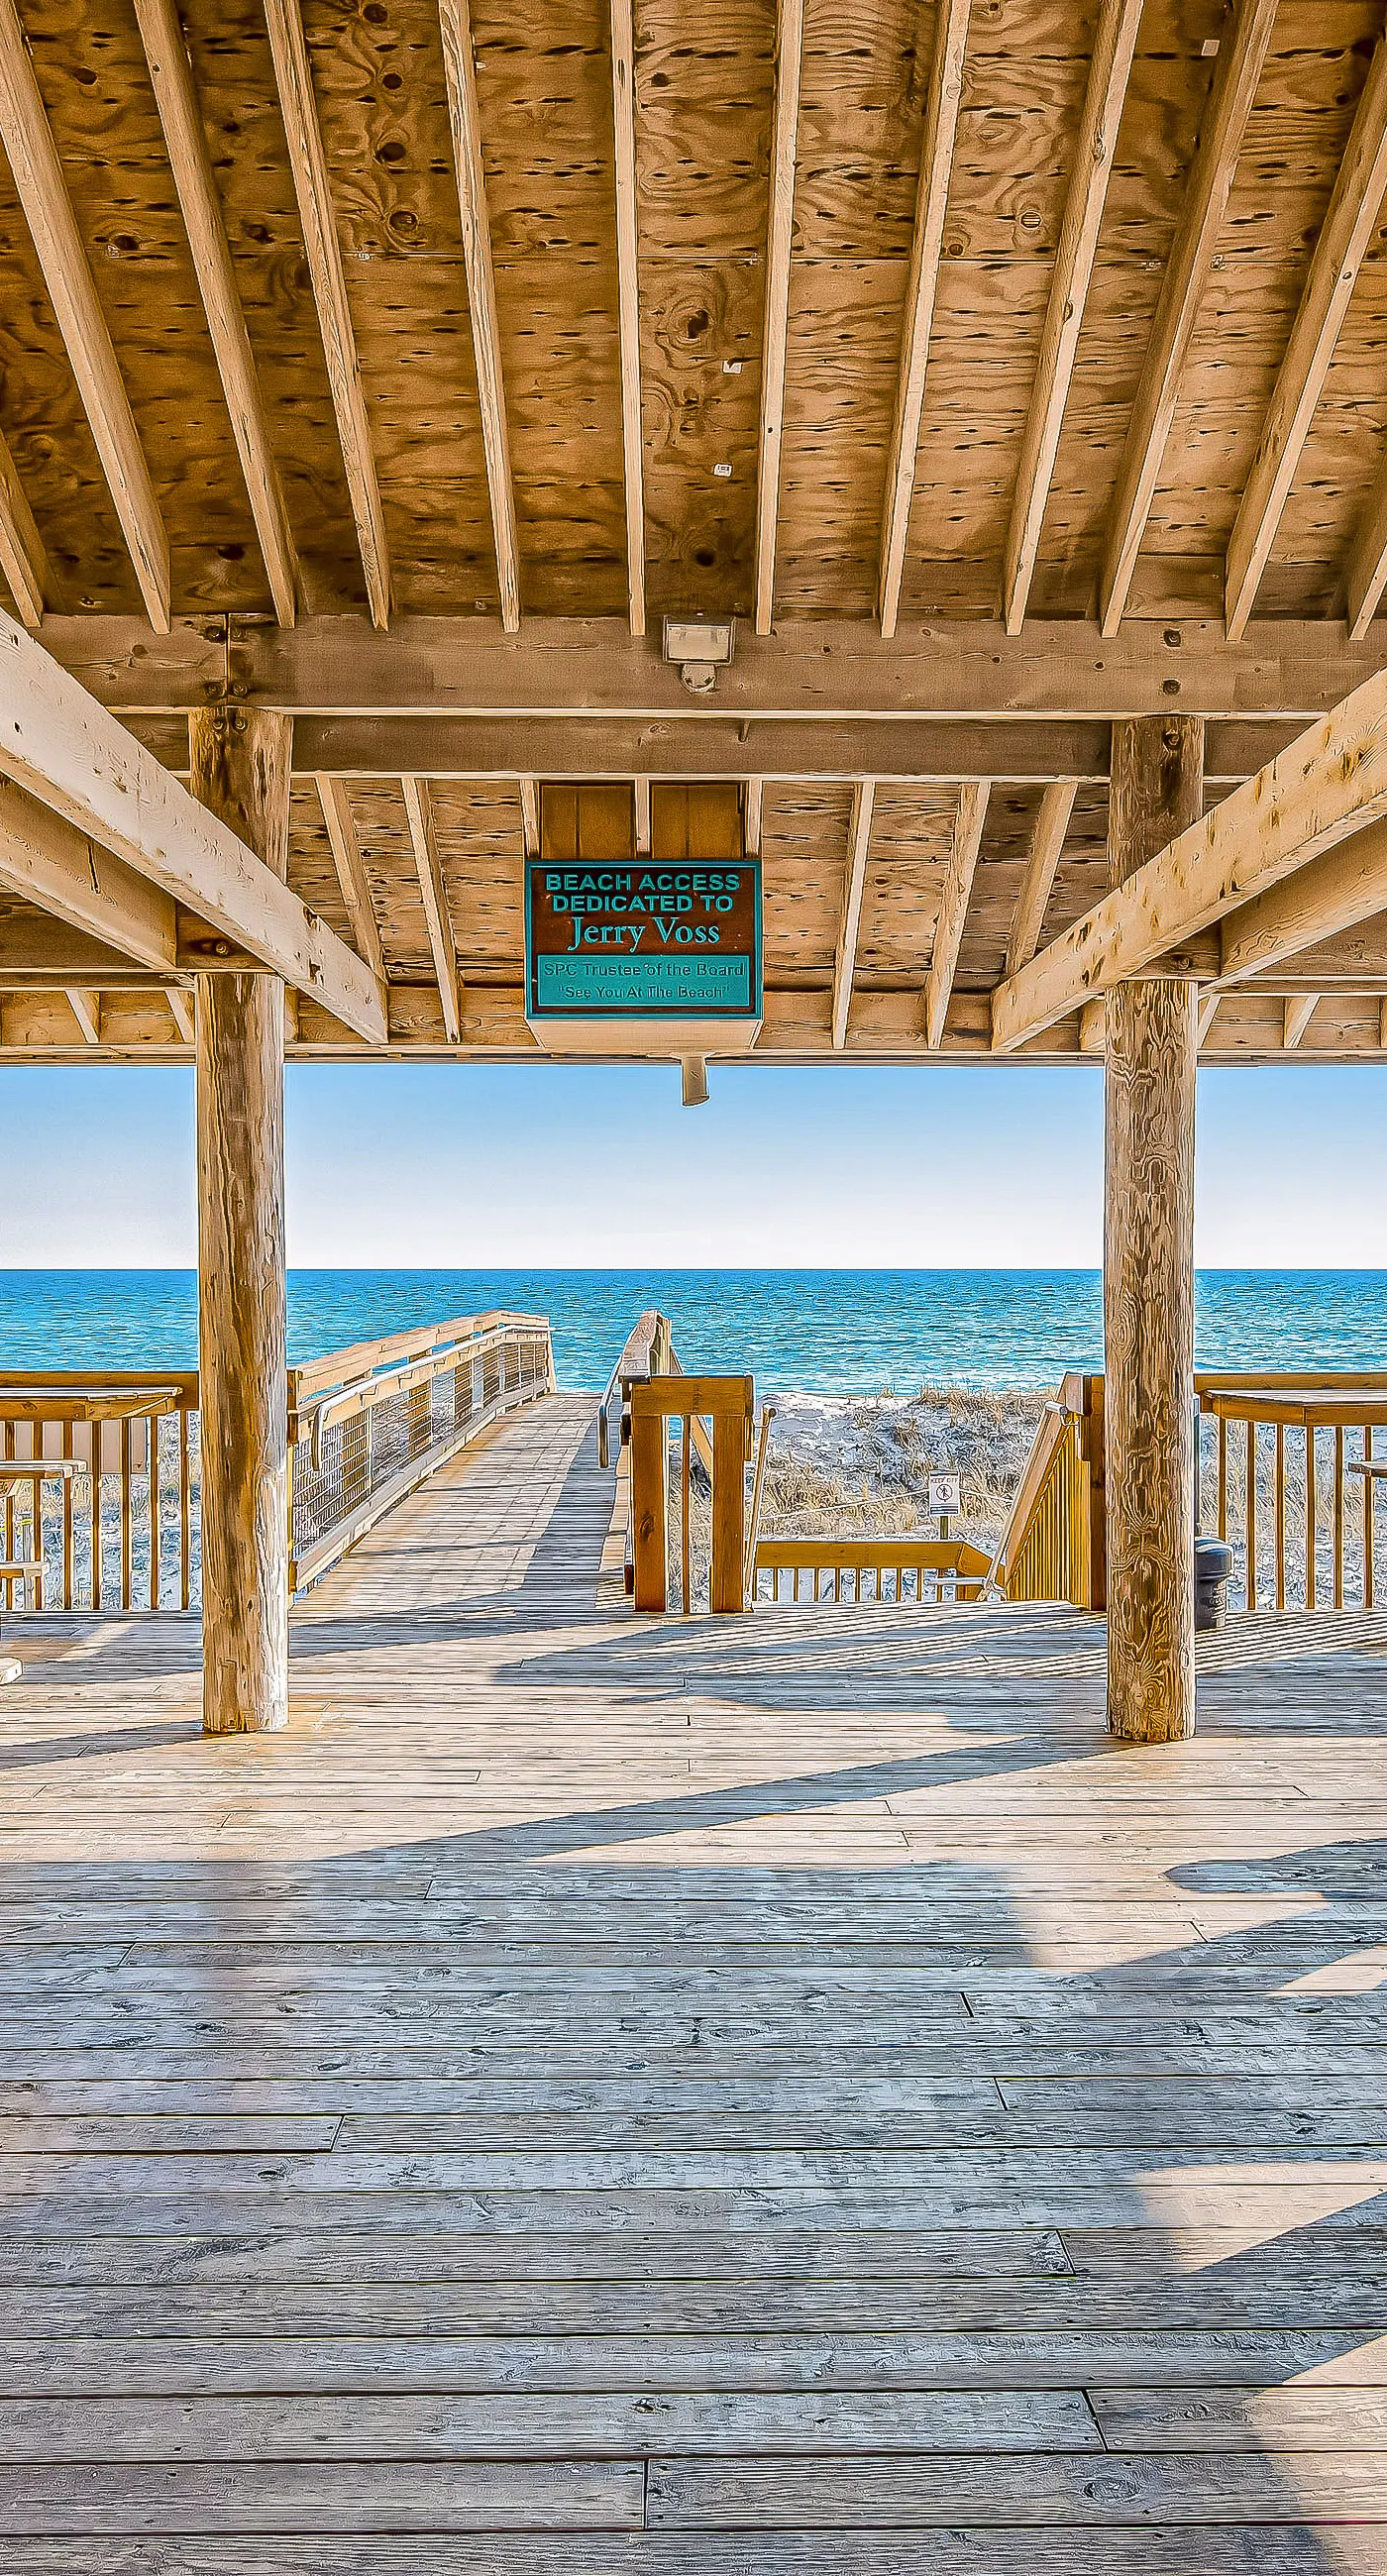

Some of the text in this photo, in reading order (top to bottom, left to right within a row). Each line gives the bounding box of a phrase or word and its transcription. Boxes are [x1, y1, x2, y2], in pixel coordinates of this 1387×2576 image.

[546, 874, 740, 891] BEACH ACCESS
[553, 895, 734, 912] DEDICATED TO
[567, 916, 720, 953] Jerry Voss
[545, 963, 744, 976] SPC Trustee of the Board
[596, 986, 623, 998] You
[626, 986, 642, 998] At
[647, 986, 673, 998] The
